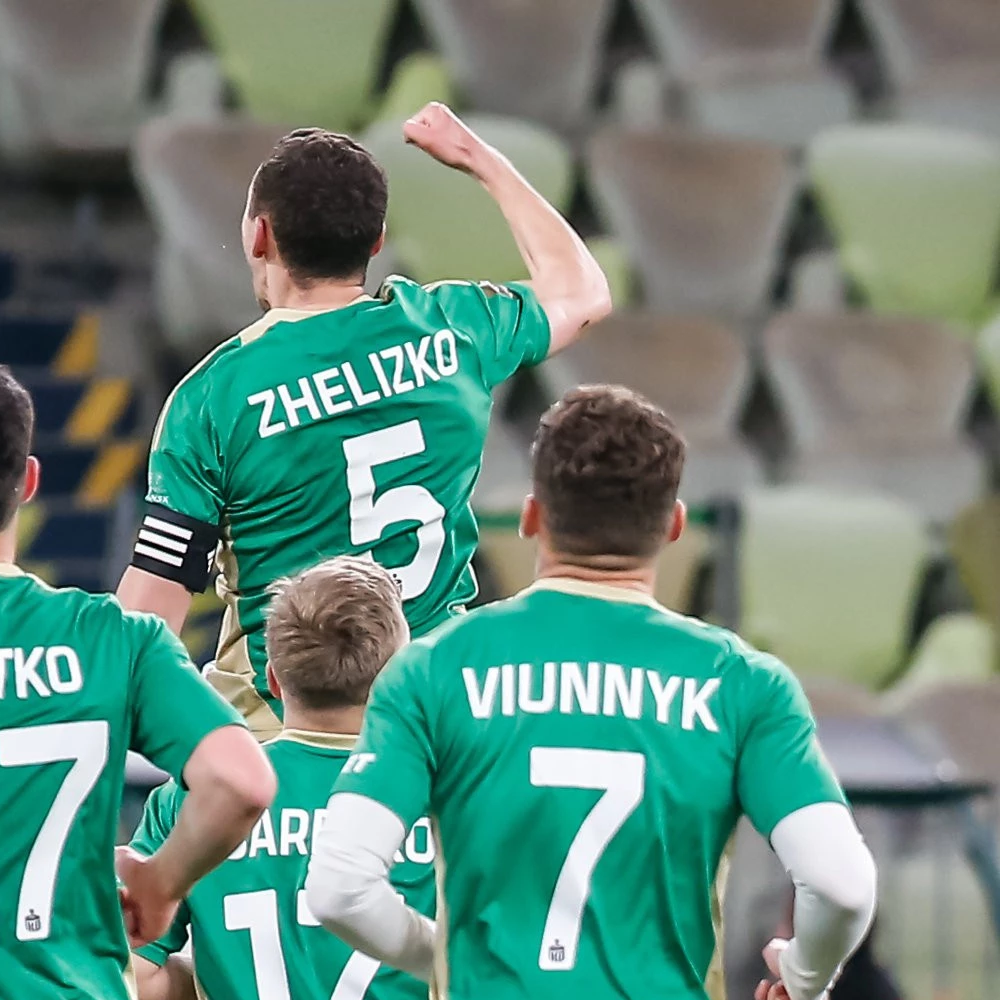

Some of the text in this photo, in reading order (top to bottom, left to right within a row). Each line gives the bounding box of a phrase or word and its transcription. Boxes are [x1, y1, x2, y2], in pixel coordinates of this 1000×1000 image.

[247, 328, 459, 438] ZHELIZKO
[343, 420, 445, 600] 5
[462, 661, 721, 732] VIUNNYK
[530, 746, 646, 971] 7
